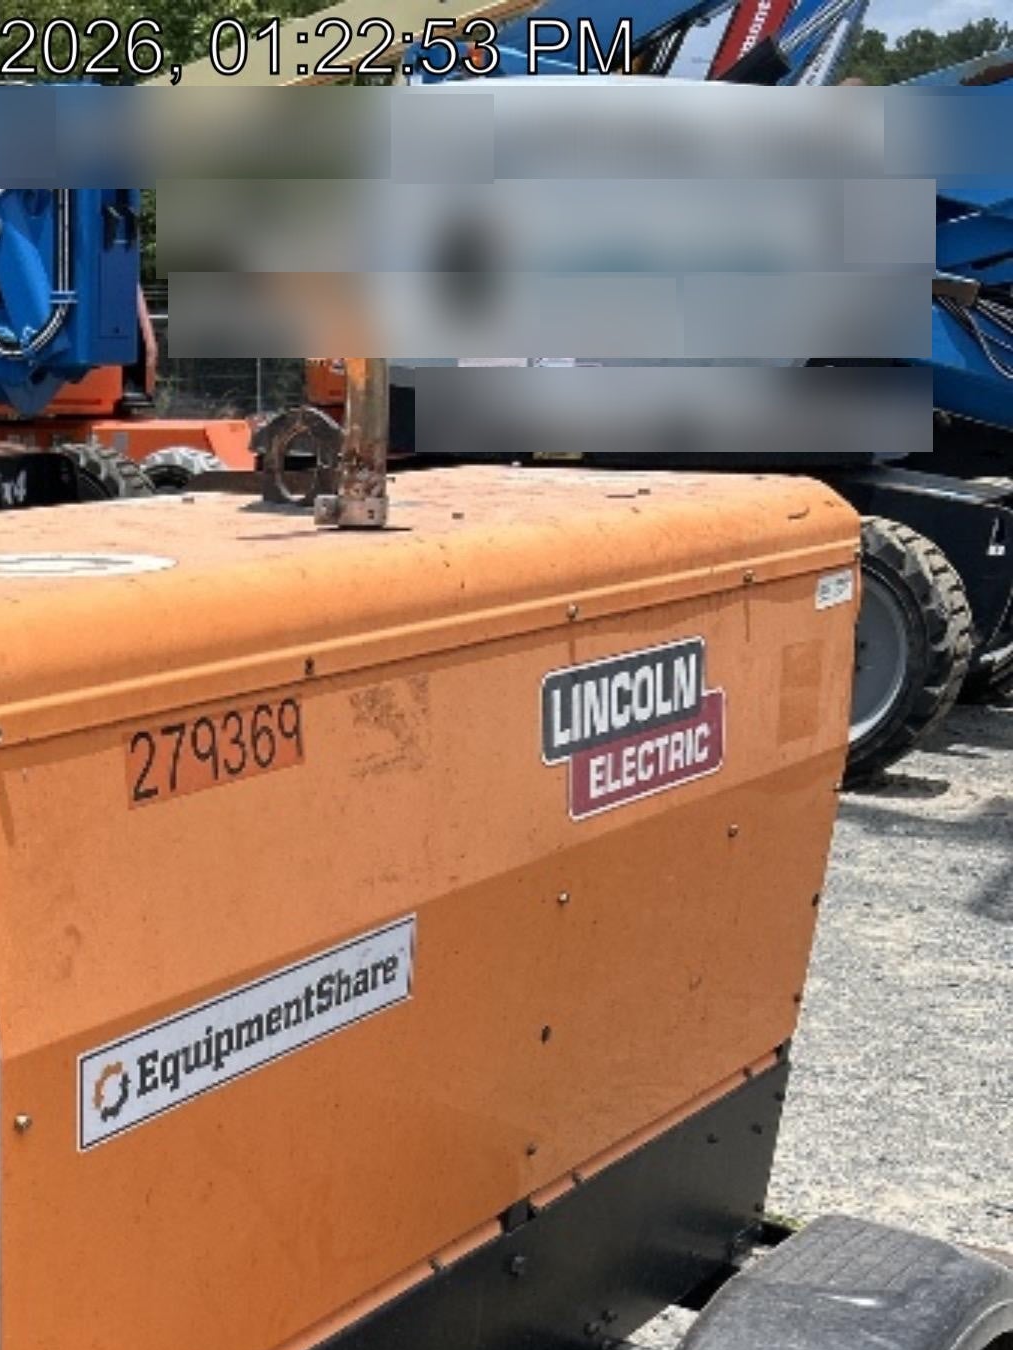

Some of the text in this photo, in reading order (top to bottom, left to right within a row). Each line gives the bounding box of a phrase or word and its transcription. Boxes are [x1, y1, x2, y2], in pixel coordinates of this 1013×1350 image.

[130, 697, 304, 802] 279369
[552, 653, 697, 748] LINCOLN
[589, 722, 711, 799] ELECTRIC
[137, 953, 399, 1098] EquipmentShare
